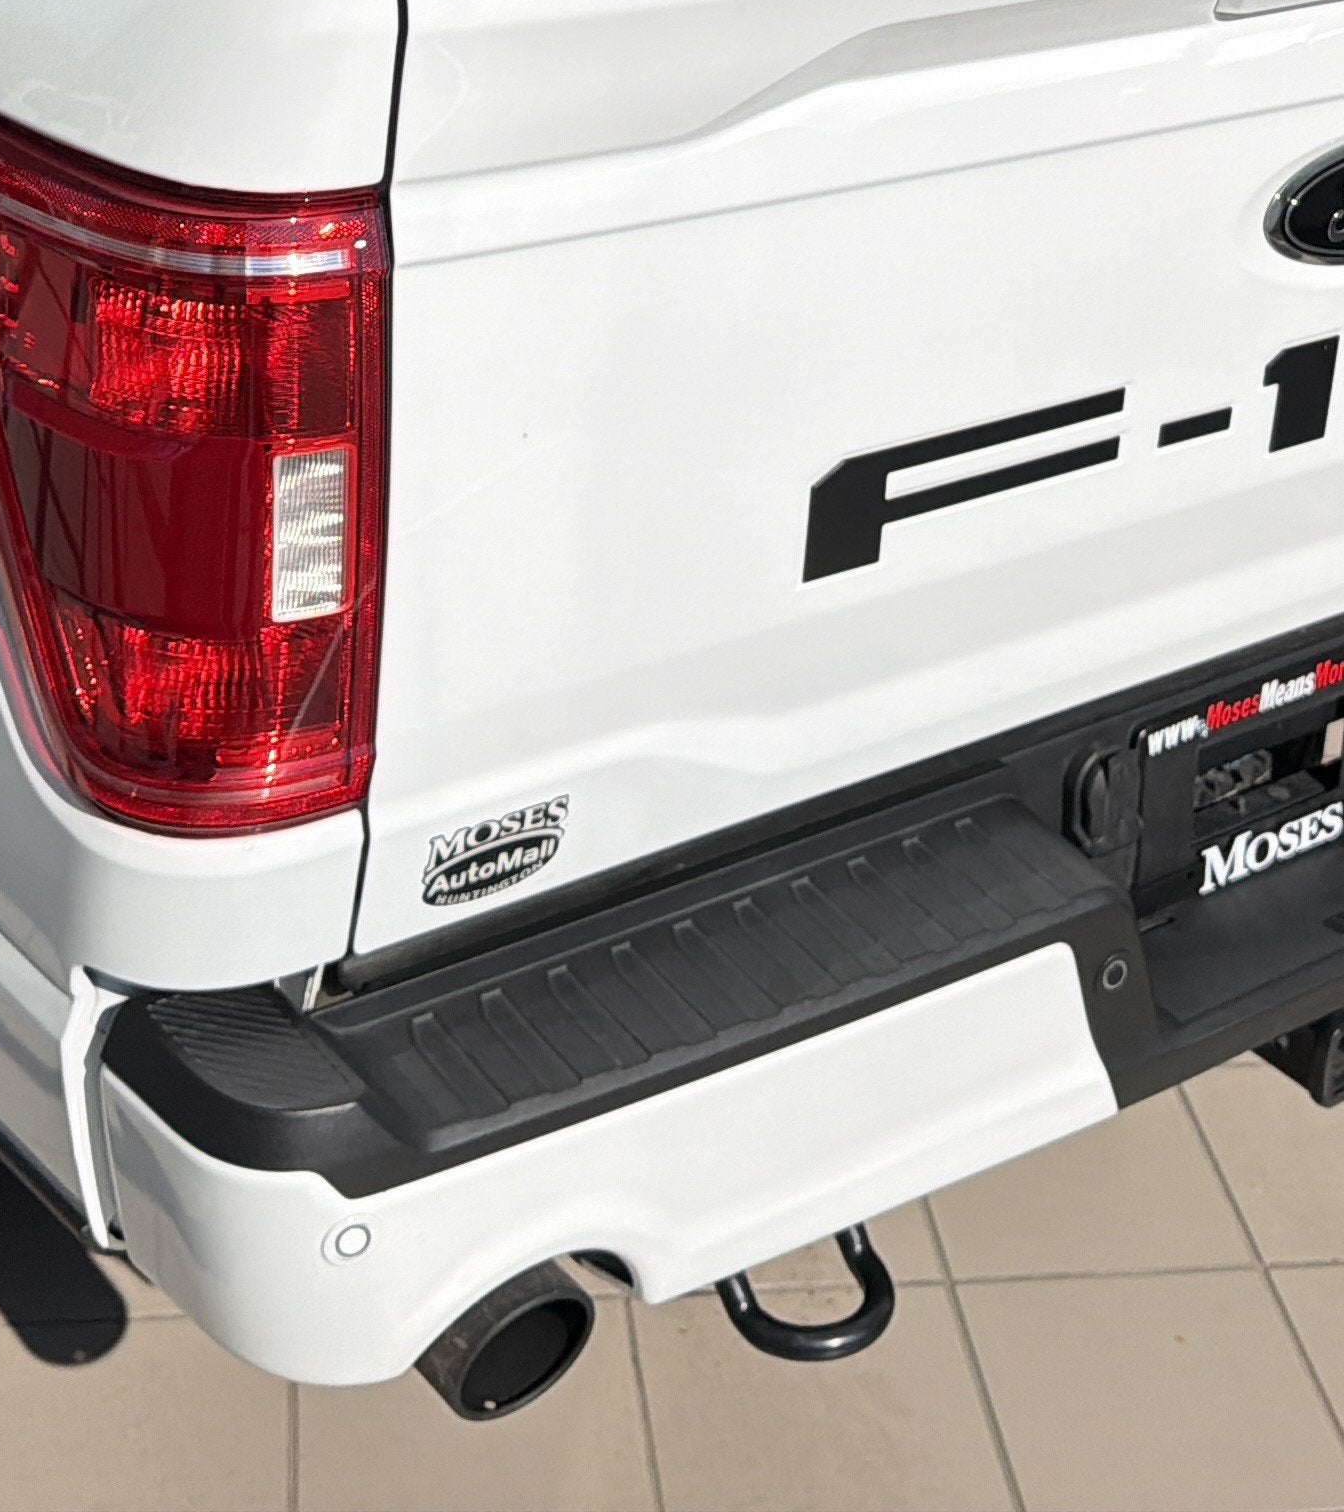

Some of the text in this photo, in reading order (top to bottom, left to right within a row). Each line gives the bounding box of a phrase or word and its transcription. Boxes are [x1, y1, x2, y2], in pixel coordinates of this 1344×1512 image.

[424, 794, 570, 874] MOSES
[427, 838, 555, 899] AutoMall
[1198, 801, 1344, 895] MOSES
